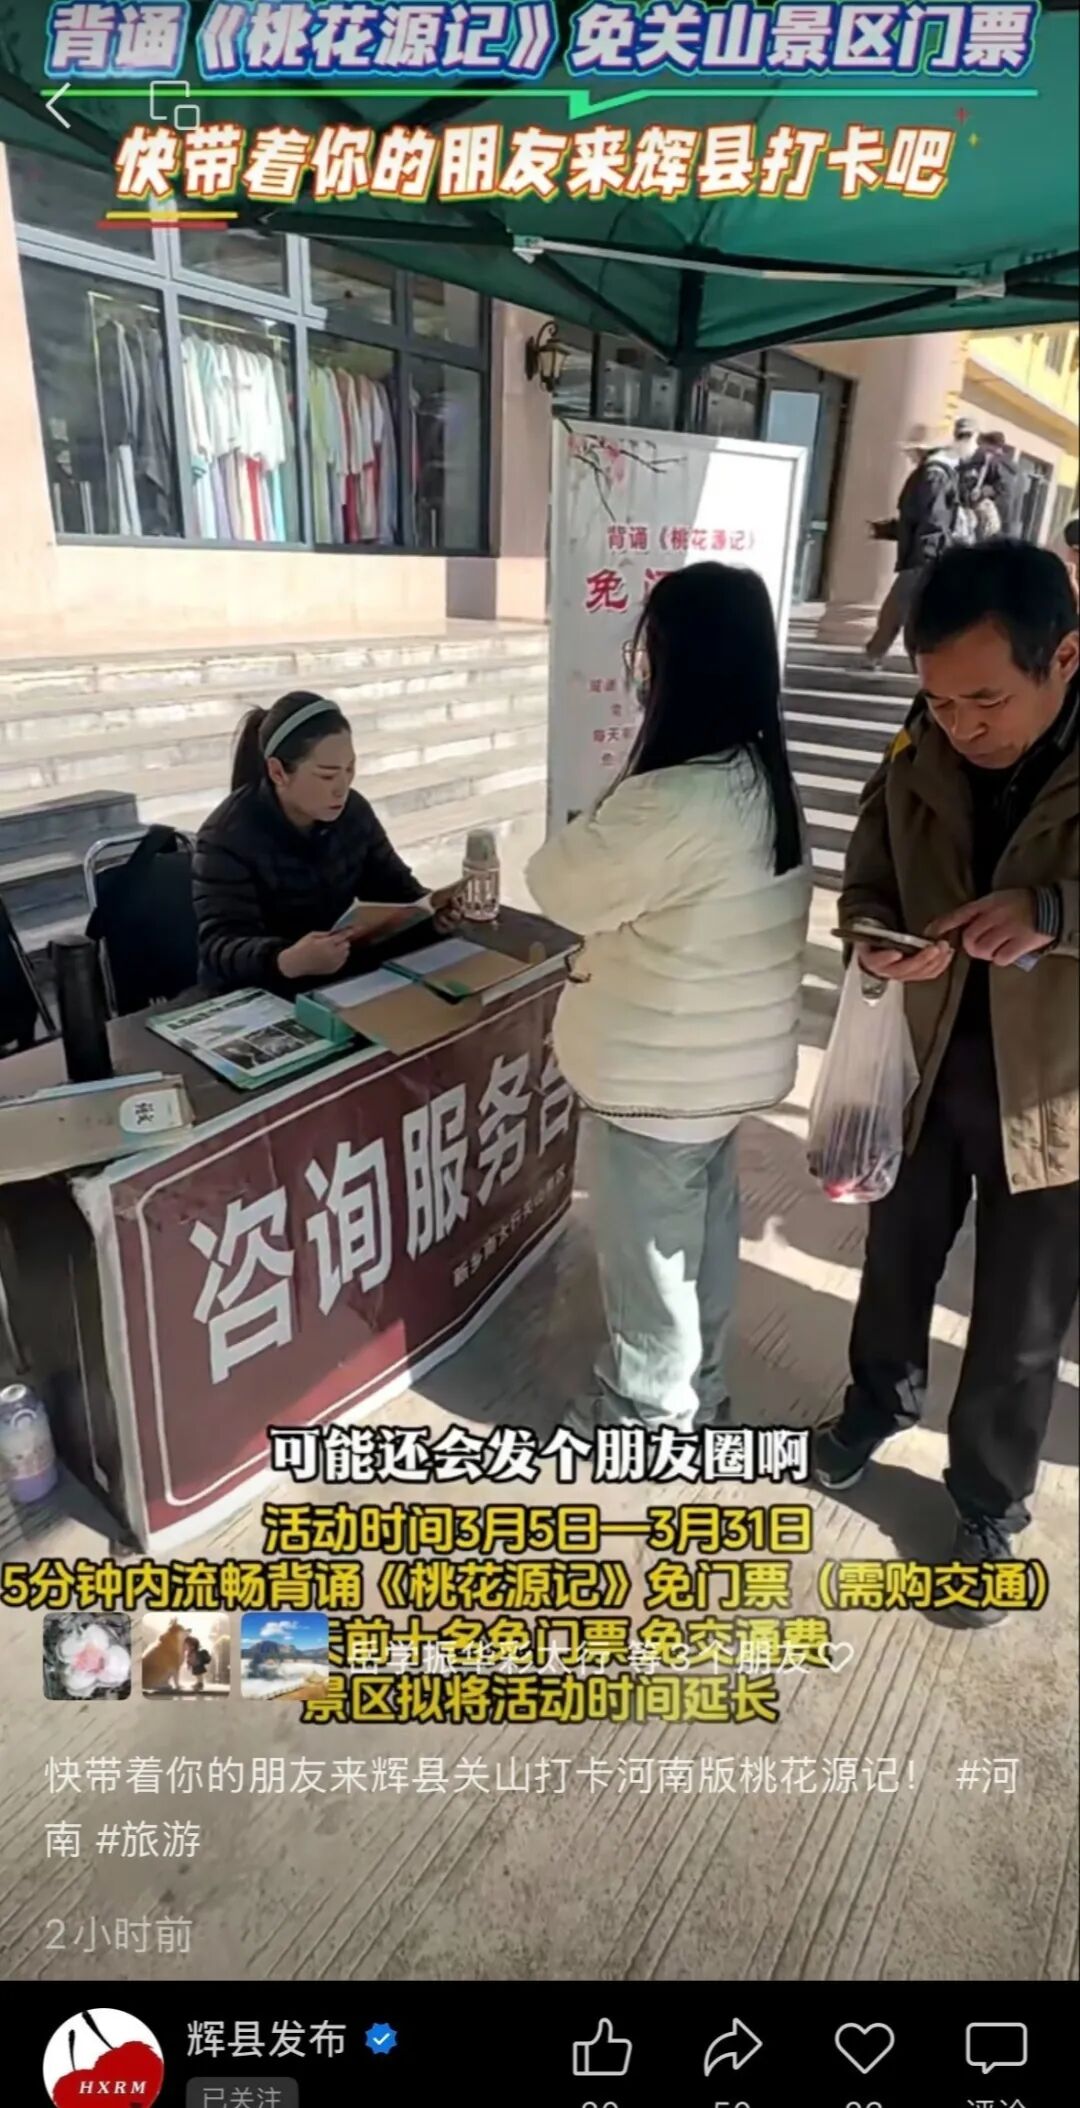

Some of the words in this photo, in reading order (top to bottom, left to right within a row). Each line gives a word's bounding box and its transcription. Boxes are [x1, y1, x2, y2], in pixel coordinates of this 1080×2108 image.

[189, 1052, 574, 1385] 咨询服务台
